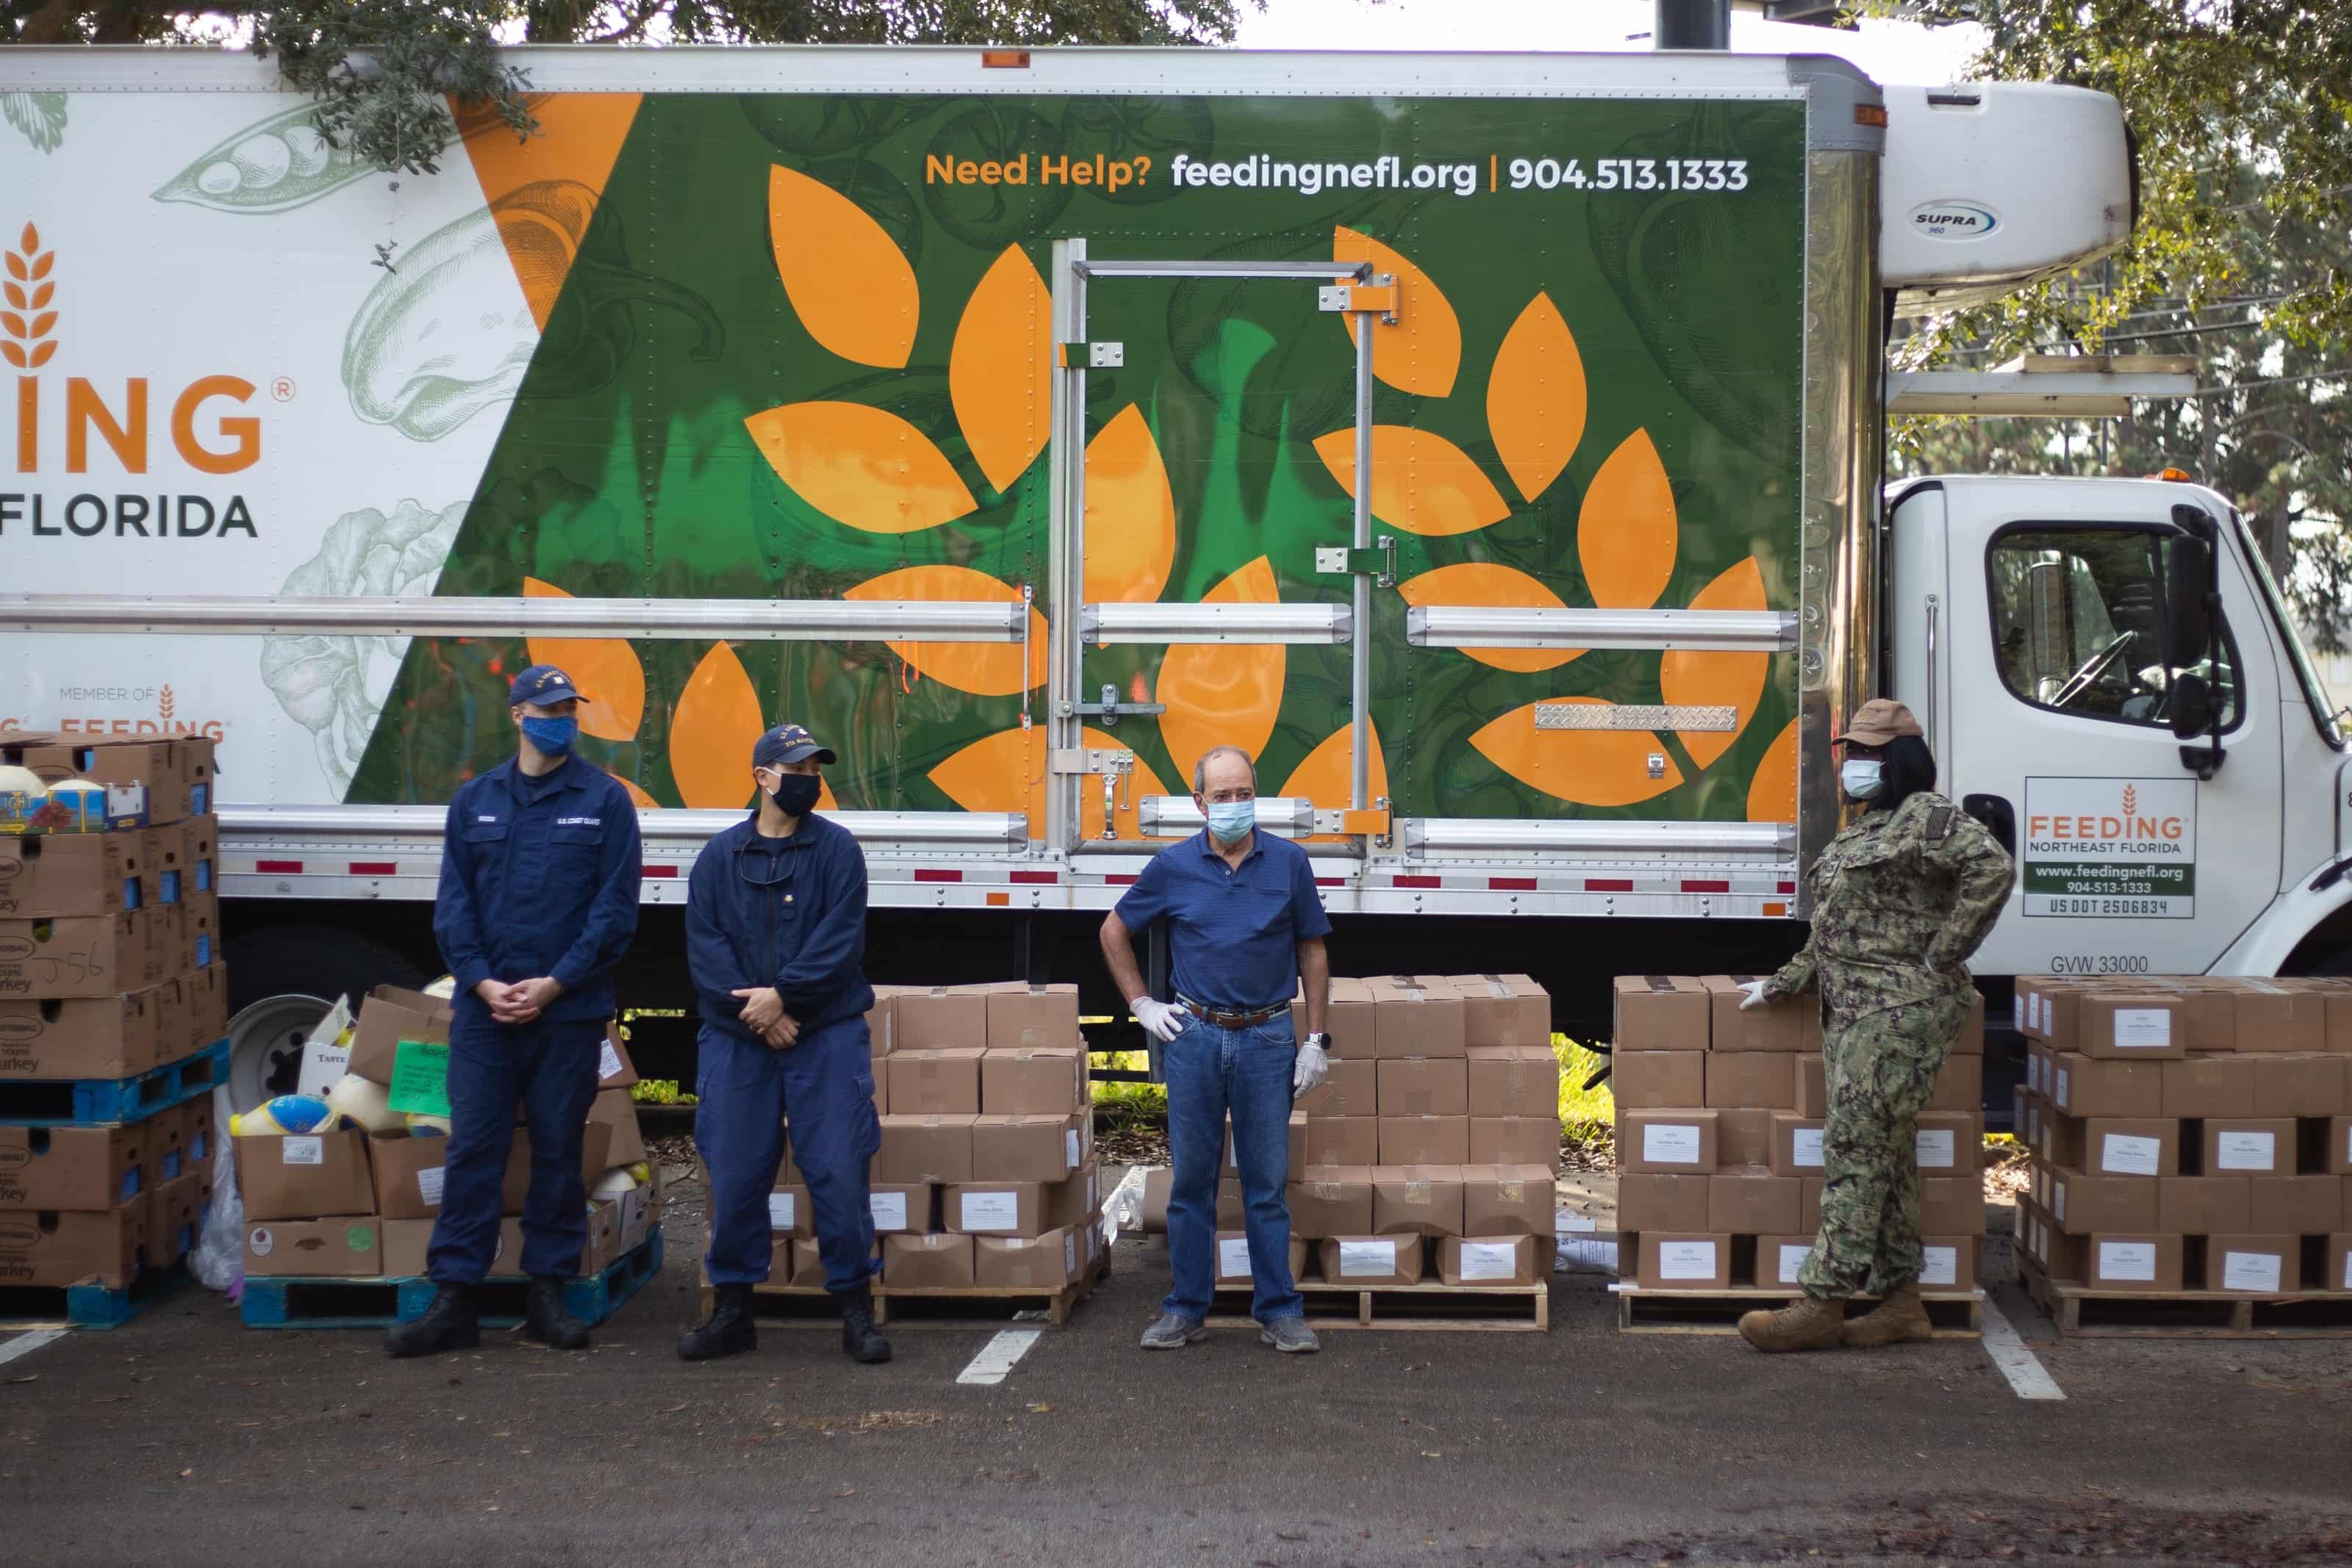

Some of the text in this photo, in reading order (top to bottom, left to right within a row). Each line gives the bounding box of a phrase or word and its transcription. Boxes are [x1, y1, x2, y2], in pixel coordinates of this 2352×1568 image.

[927, 154, 1748, 196] Need Help? feedingnefl.org 904.513.1333
[1916, 214, 1976, 226] SUPRA
[1928, 226, 1945, 234] 960
[0, 493, 258, 538] FLORIDA
[60, 687, 154, 700] MEMBER OF
[60, 719, 223, 744] FEEDING
[2030, 816, 2182, 840] FEEDING
[2030, 842, 2181, 853] NORTHEAST FLORIDA
[2035, 864, 2183, 881] www.feedingnefl.org
[2067, 881, 2151, 893] 904-513-1333
[2051, 956, 2148, 973] GVW 33000
